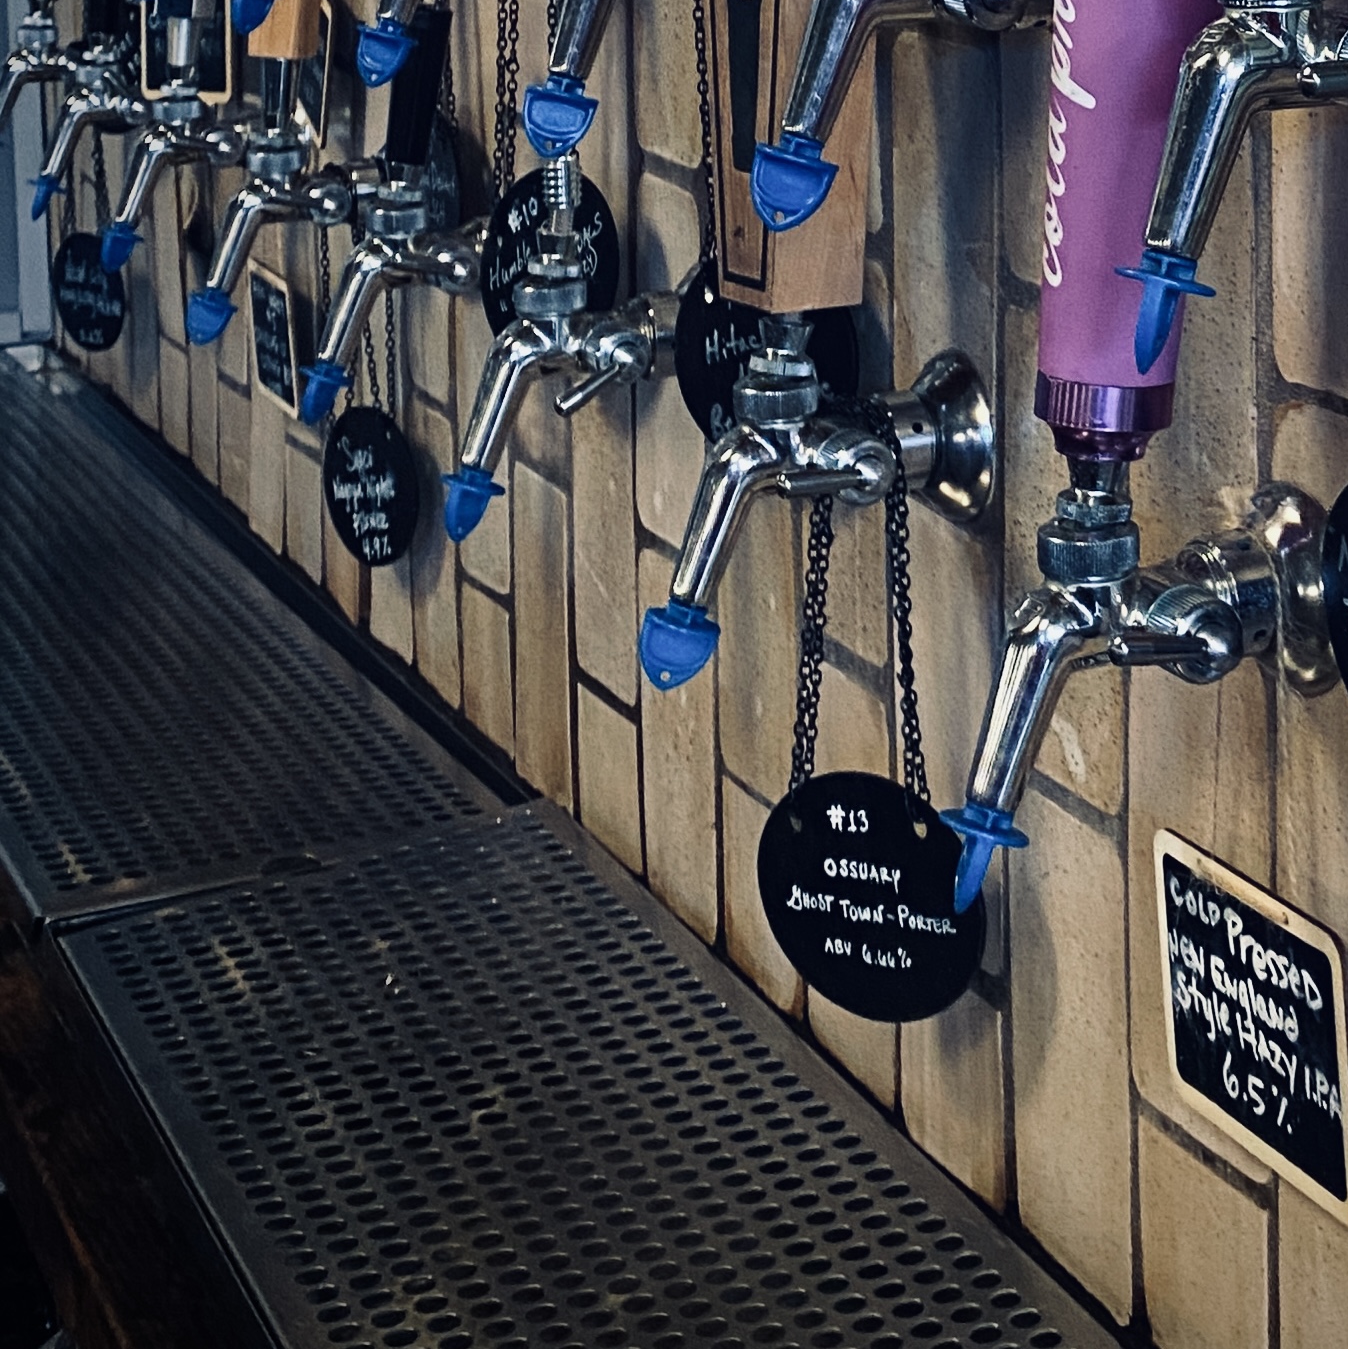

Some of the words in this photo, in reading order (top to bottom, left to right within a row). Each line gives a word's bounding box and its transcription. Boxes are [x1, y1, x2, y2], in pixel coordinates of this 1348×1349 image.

[705, 322, 763, 365] Hitac
[826, 803, 869, 833] #13
[823, 857, 901, 894] OSSUARY
[786, 884, 834, 913] GHOST
[824, 937, 851, 956] ABV
